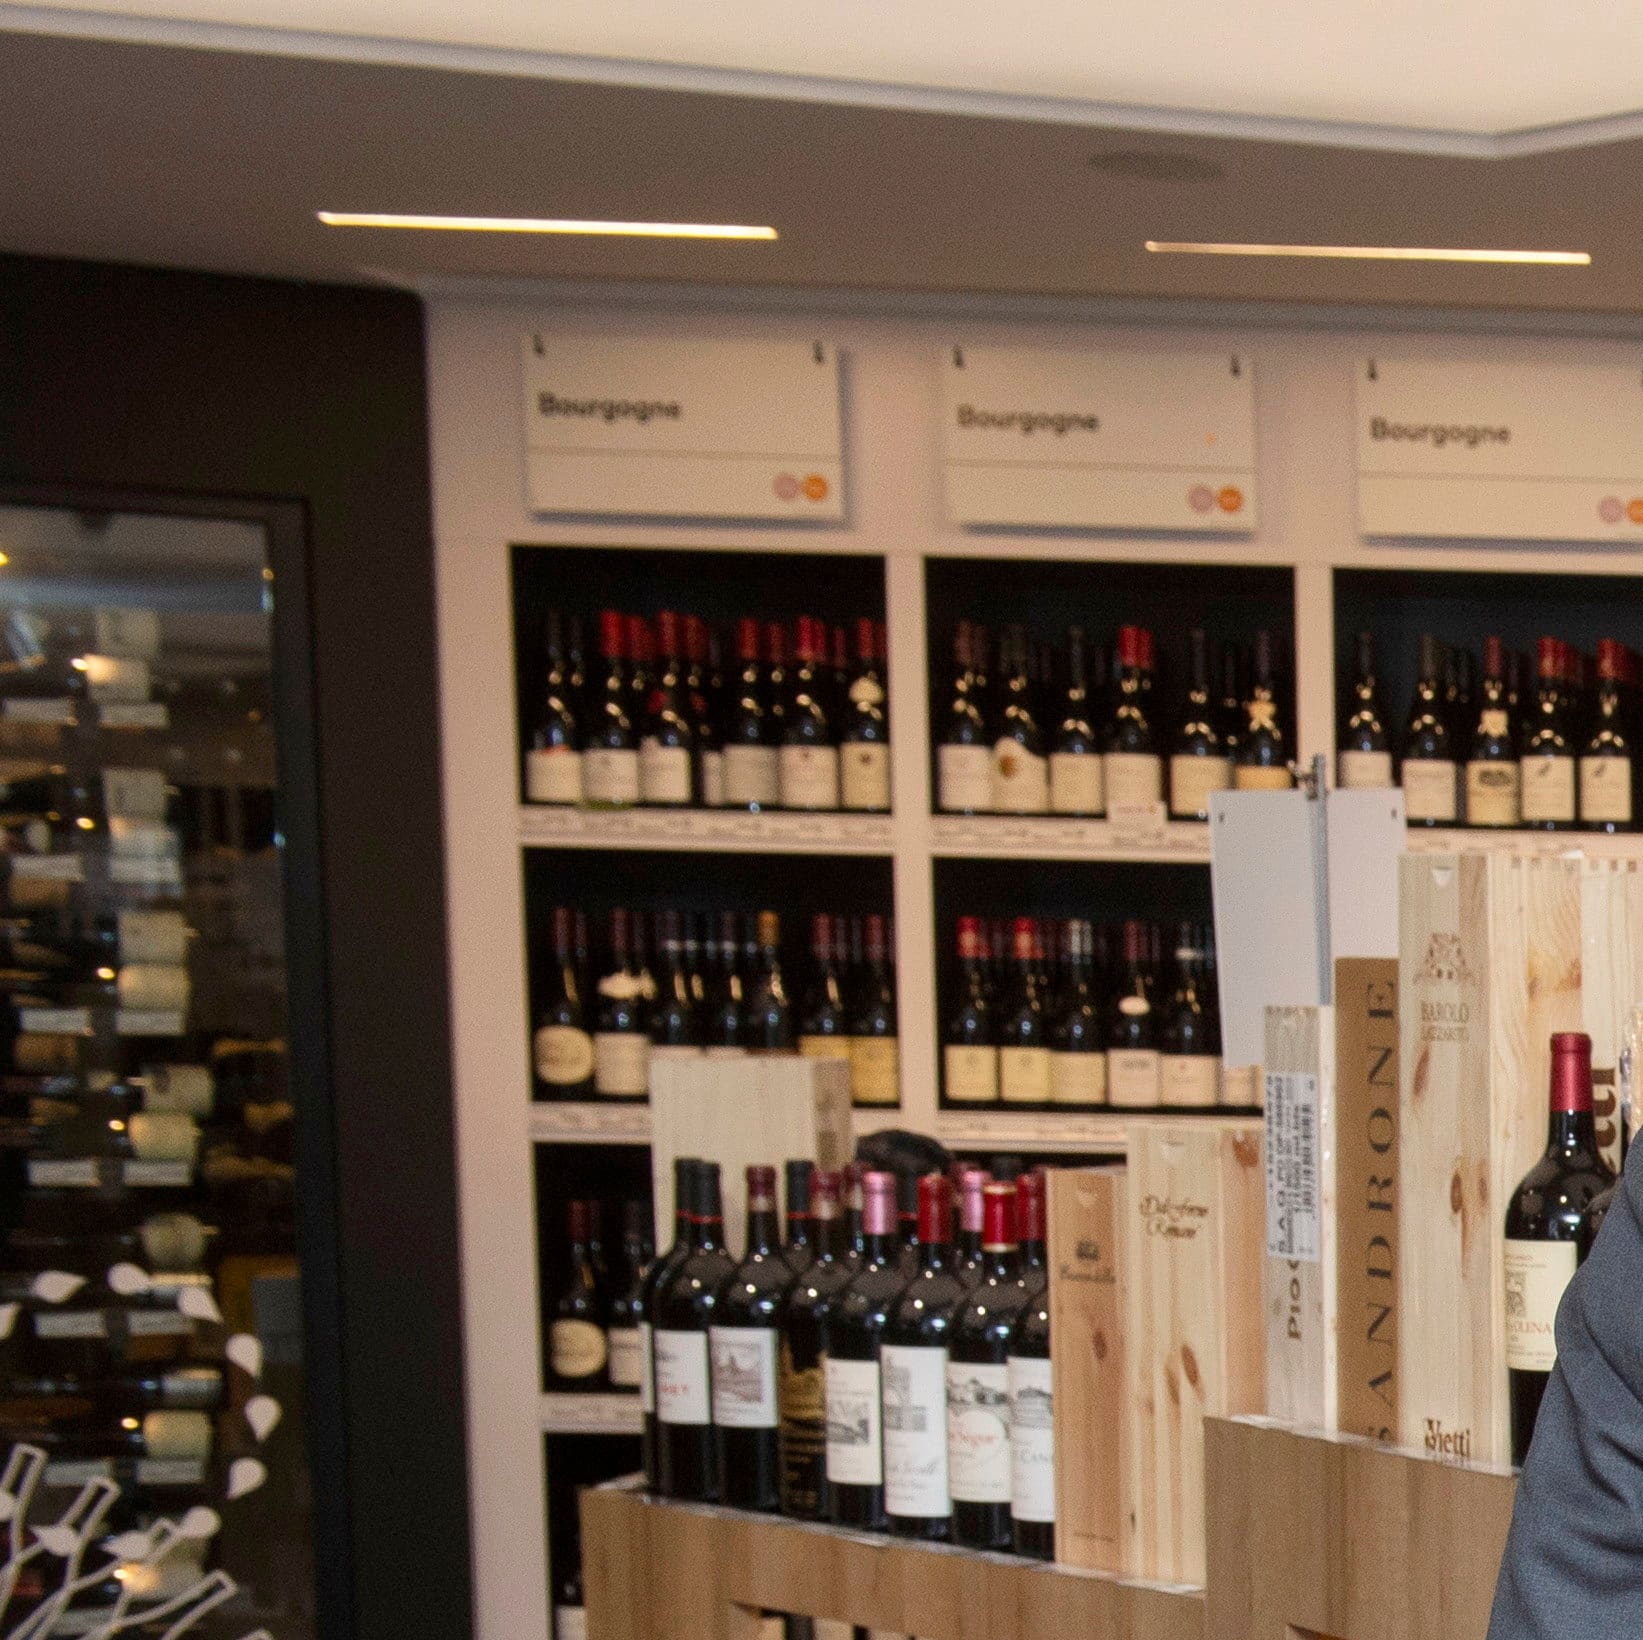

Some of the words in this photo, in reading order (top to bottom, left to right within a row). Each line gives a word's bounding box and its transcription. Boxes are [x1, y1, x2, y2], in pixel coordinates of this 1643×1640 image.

[538, 391, 681, 424] Bourgogne
[957, 403, 1098, 436] Bourgogne
[1370, 416, 1510, 449] Bourgogne
[1366, 980, 1397, 1442] SANDRONE
